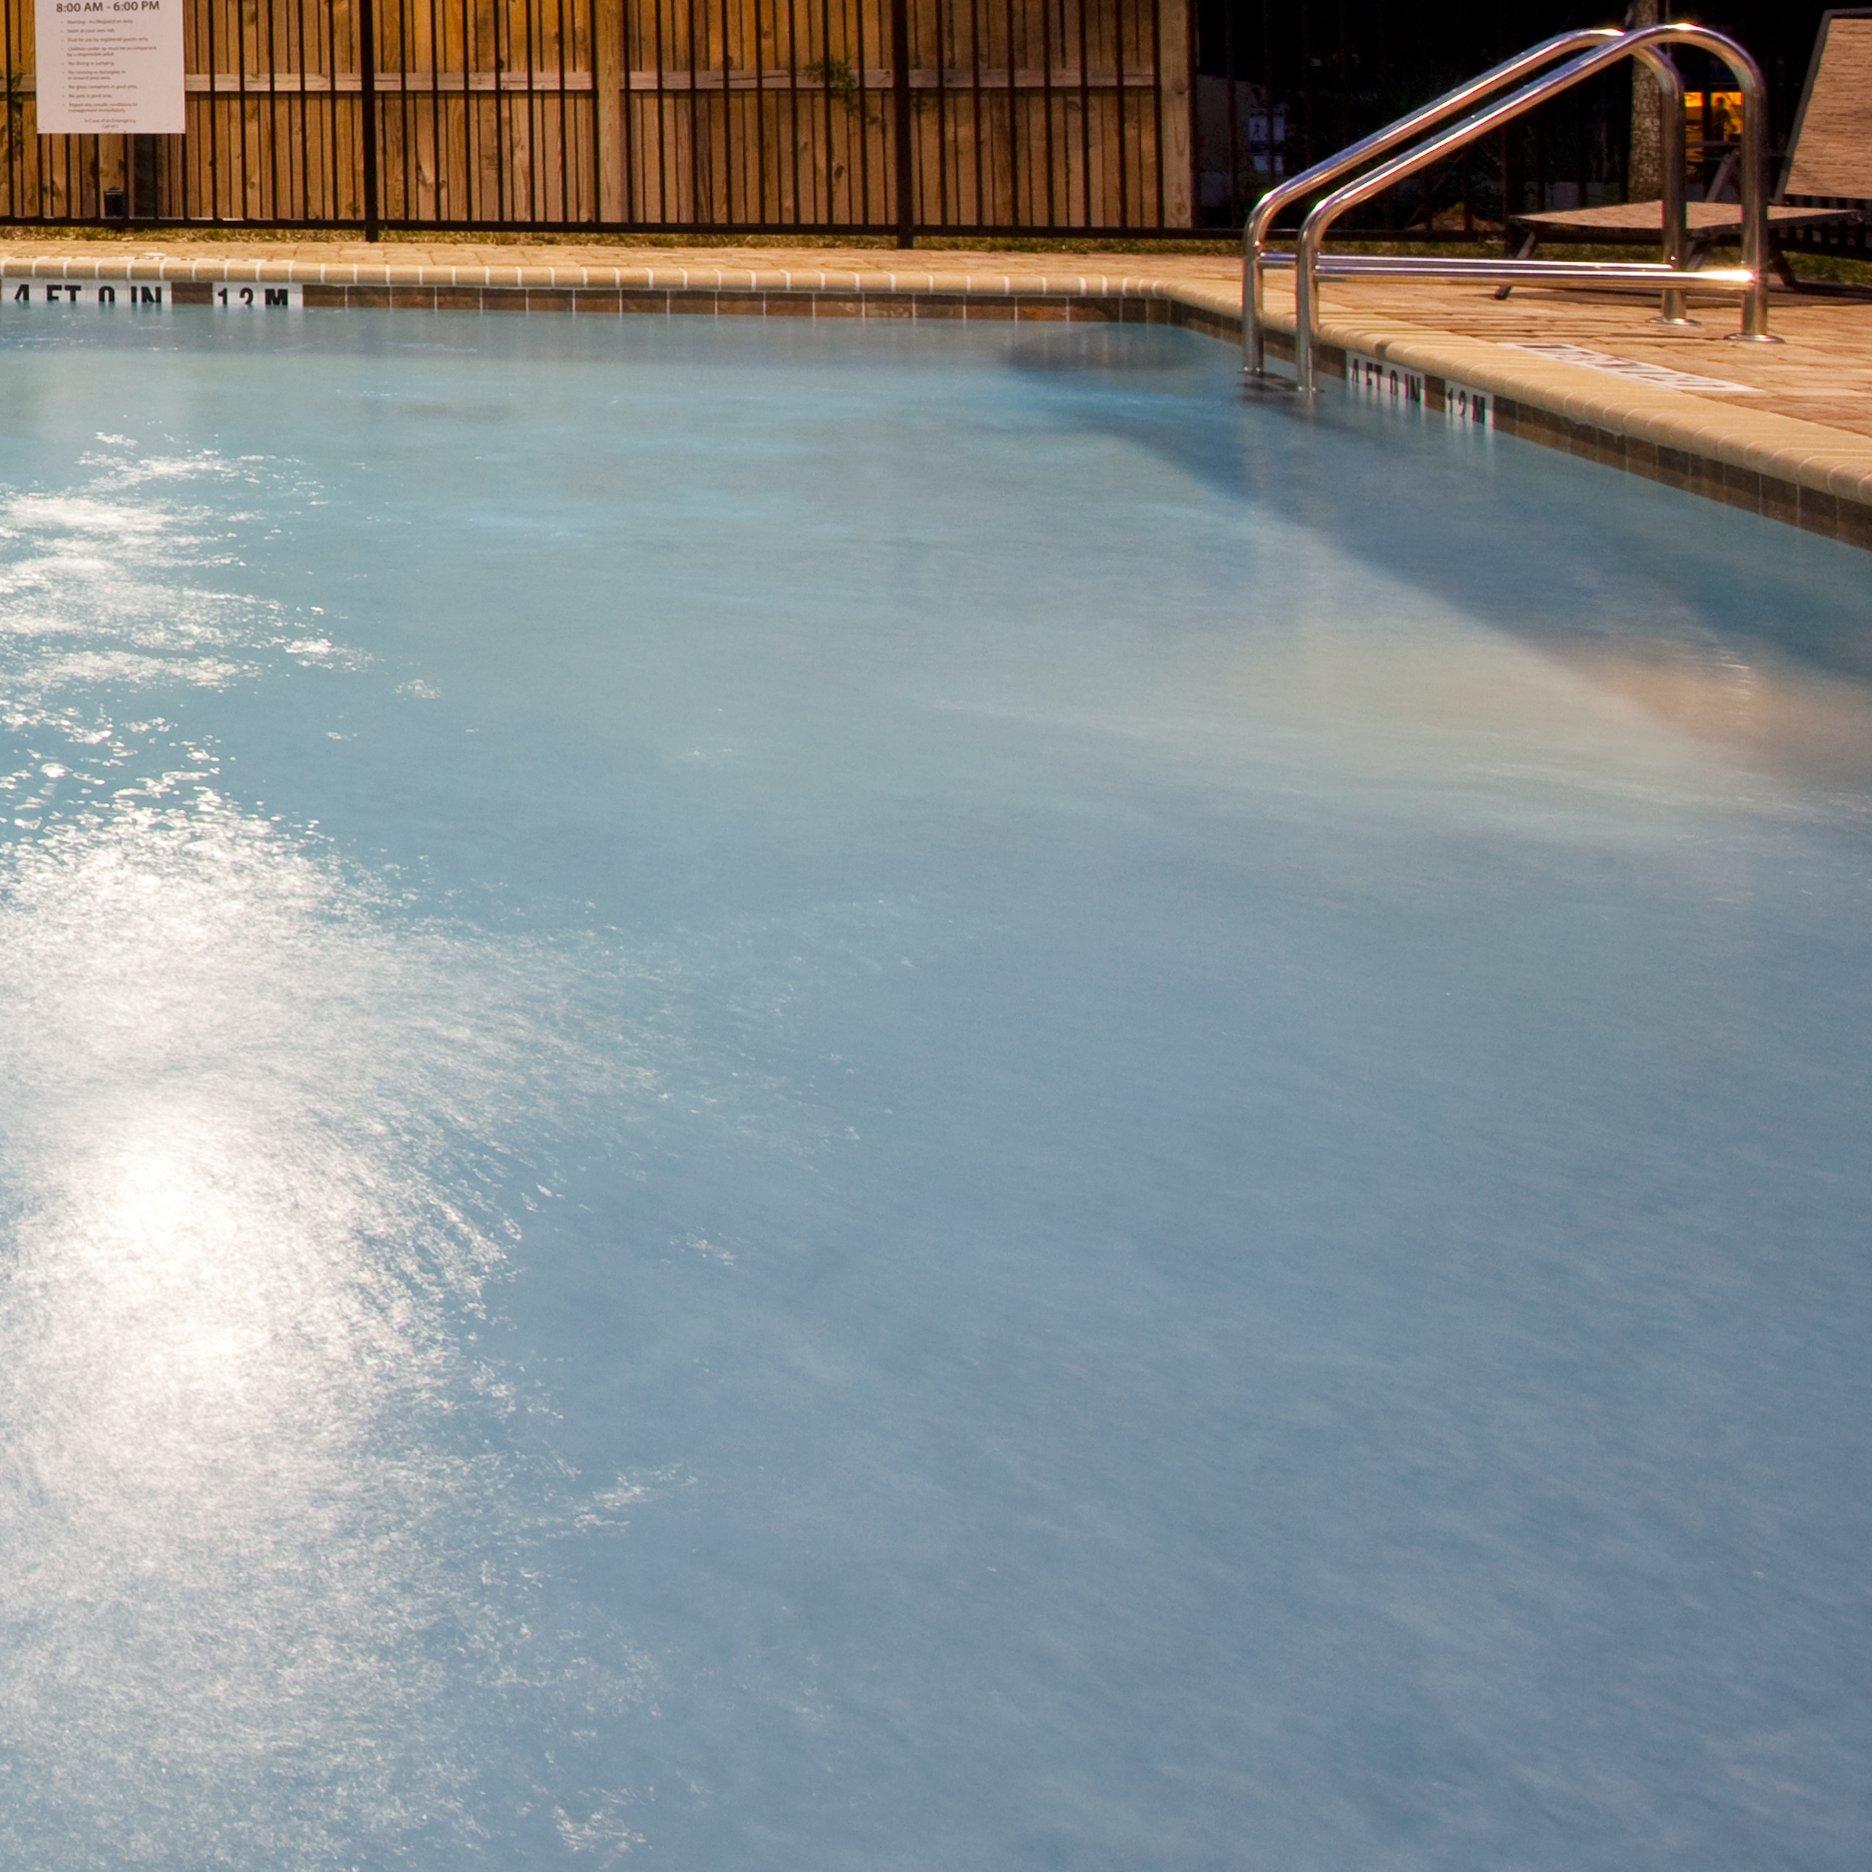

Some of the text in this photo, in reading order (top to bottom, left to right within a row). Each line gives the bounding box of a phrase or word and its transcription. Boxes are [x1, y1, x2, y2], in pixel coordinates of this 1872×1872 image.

[56, 2, 81, 13] 8:00
[84, 1, 103, 12] AM
[113, 0, 138, 12] 6:00
[141, 0, 160, 11] PM
[46, 284, 82, 302] FT
[130, 286, 162, 303] IN
